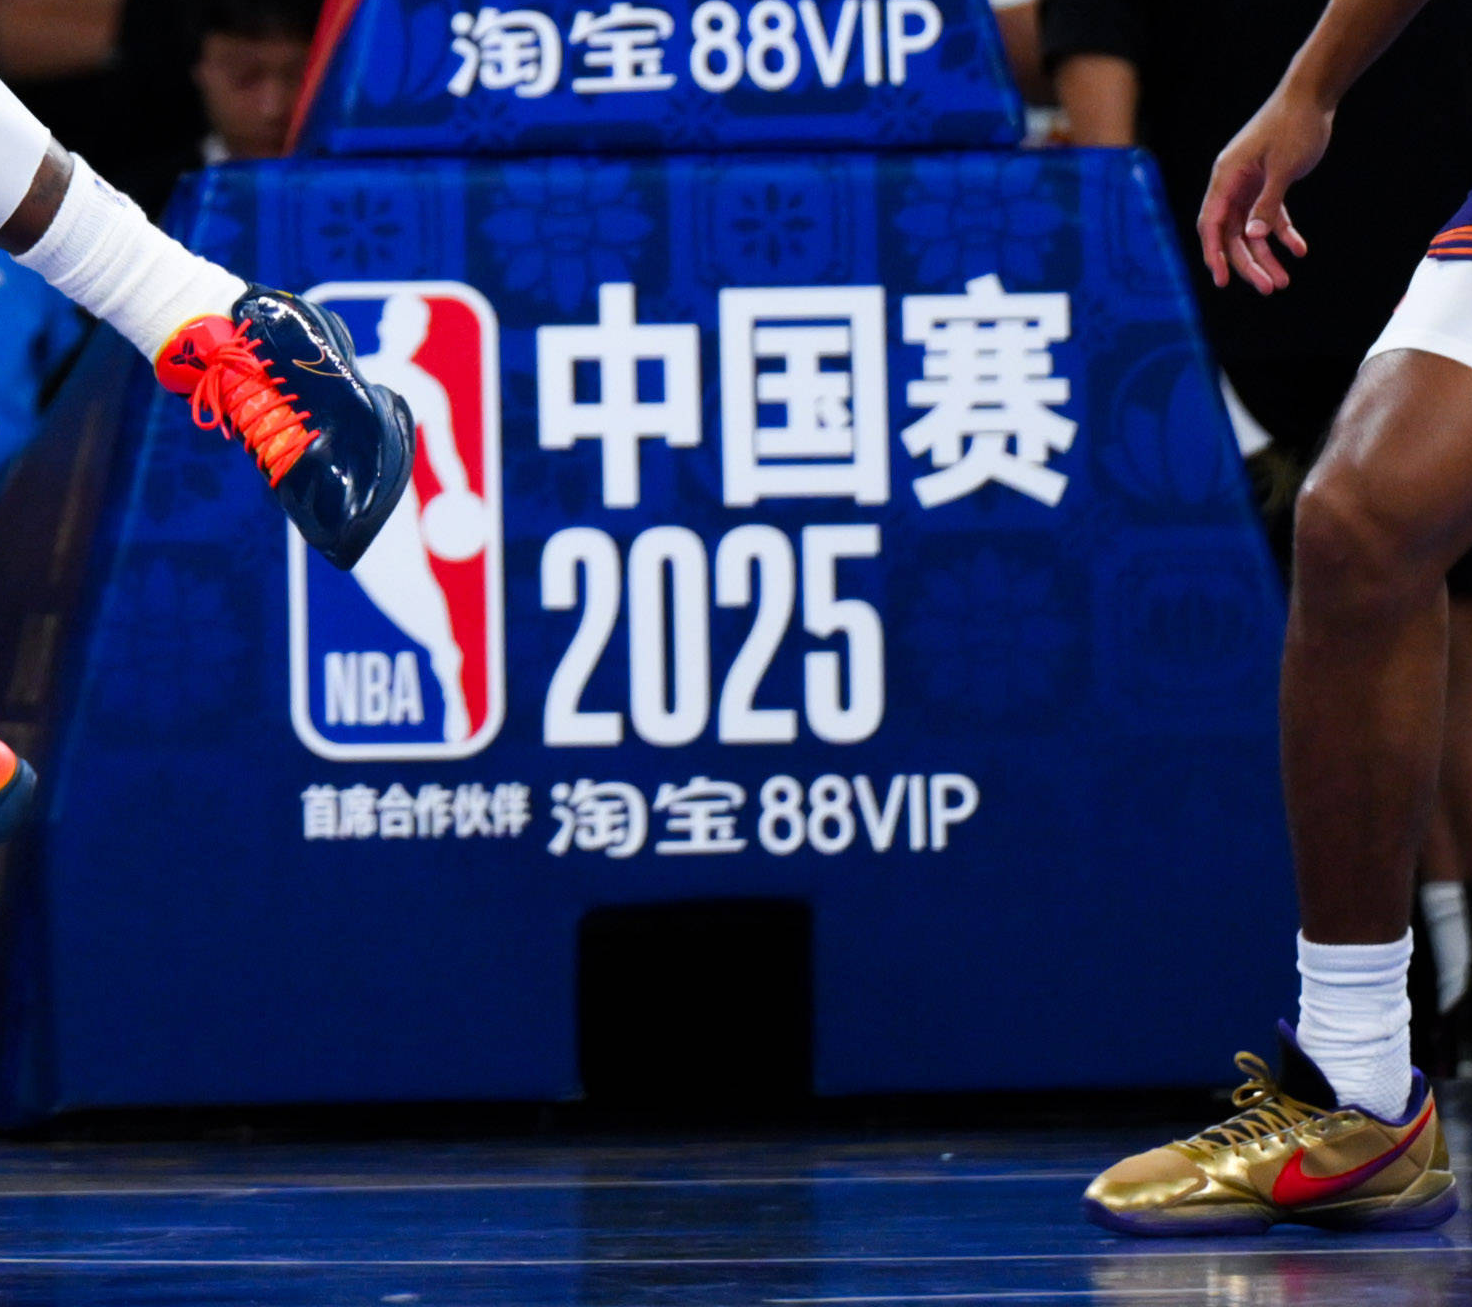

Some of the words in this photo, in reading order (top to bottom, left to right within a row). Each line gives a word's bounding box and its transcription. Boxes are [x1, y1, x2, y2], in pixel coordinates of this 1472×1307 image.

[535, 272, 1079, 510] 中国赛
[323, 650, 425, 727] NBA
[539, 522, 887, 748] 2025
[299, 780, 532, 841] 首席合作伙伴
